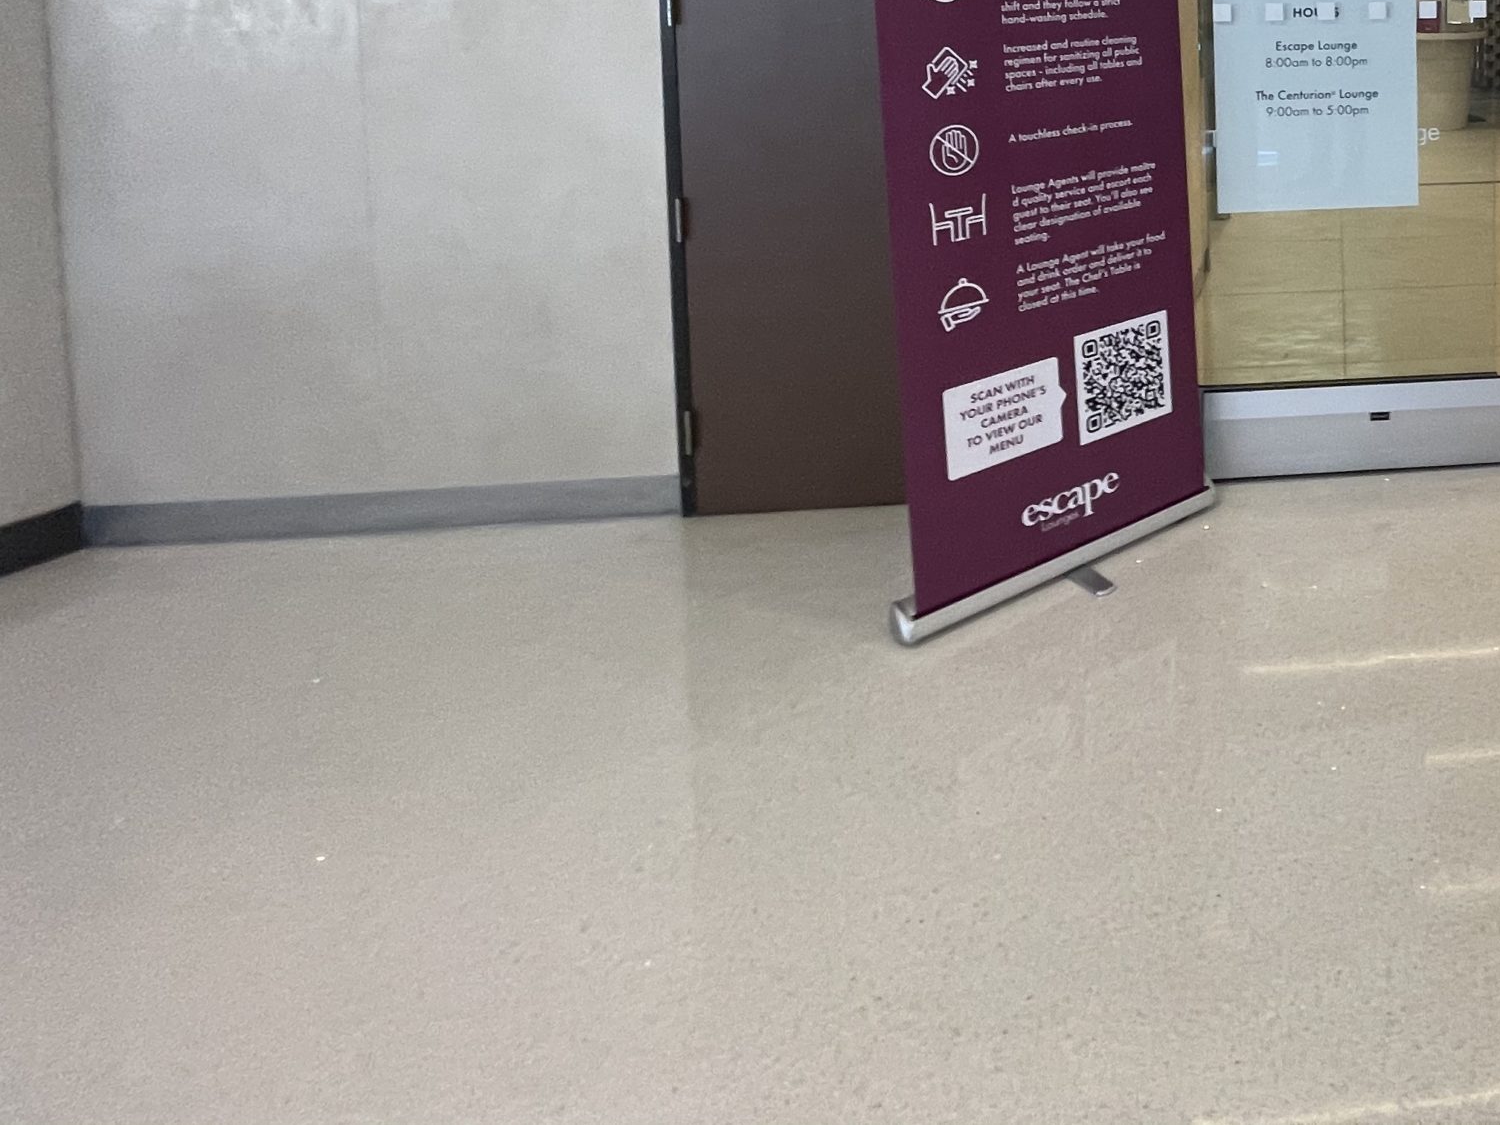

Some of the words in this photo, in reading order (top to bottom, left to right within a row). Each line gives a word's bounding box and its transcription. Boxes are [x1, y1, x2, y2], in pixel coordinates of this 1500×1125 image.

[1001, 1, 1020, 11] shift
[1022, 0, 1040, 10] and
[1043, 0, 1062, 10] they
[1293, 7, 1339, 18] HOS
[1002, 11, 1067, 24] hand-washing
[1003, 40, 1048, 53] Increased
[1050, 39, 1068, 49] and
[1070, 38, 1100, 47] routine
[1102, 35, 1137, 45] cleaning
[1276, 41, 1314, 53] Escape
[1318, 40, 1357, 52] Lounge
[1004, 55, 1041, 68] regimen
[1044, 53, 1057, 62] for
[1060, 50, 1100, 61] sanitizing
[1102, 48, 1112, 57] all
[1114, 46, 1140, 58] public
[1265, 58, 1308, 68] 8:00am
[1312, 57, 1321, 66] to
[1326, 56, 1368, 69] 8:00pm
[1005, 70, 1036, 82] spaces
[1045, 63, 1085, 75] including
[1087, 61, 1097, 70] all
[1126, 57, 1142, 66] and
[1006, 80, 1033, 92] chairs
[1035, 78, 1056, 88] after
[1059, 77, 1084, 86] every
[1256, 91, 1274, 101] The
[1339, 89, 1379, 101] Lounge
[1266, 107, 1309, 116] 9:00am
[1313, 107, 1323, 116] to
[1326, 105, 1369, 117] 5:00pm
[1008, 134, 1016, 143] A
[1019, 128, 1060, 142] touchless
[1062, 123, 1098, 136] check-in
[1011, 182, 1045, 194] Lounge
[1048, 176, 1079, 189] Agents
[1081, 171, 1095, 181] will
[1097, 166, 1128, 180] provide
[1021, 192, 1053, 206] quality
[1055, 187, 1085, 199] service
[1088, 181, 1104, 192] and
[1106, 177, 1131, 189] escort
[1132, 173, 1151, 184] each
[1013, 208, 1037, 222] guest
[1040, 205, 1049, 214] to
[1051, 200, 1071, 212] their
[1121, 189, 1137, 199] also
[1013, 220, 1036, 232] clear
[1039, 210, 1091, 226] designation
[1093, 205, 1101, 216] of
[1016, 264, 1025, 274] A
[1027, 258, 1059, 272] Lounge
[1062, 251, 1089, 264] Agent
[1091, 245, 1105, 256] will
[1107, 242, 1124, 252] take
[1126, 237, 1144, 249] your
[1146, 231, 1166, 243] food
[1017, 275, 1035, 286] and
[1037, 267, 1060, 282] drink
[1062, 263, 1087, 275] order
[1089, 257, 1105, 269] and
[1107, 250, 1135, 264] deliver
[1018, 289, 1039, 302] your
[1065, 276, 1080, 287] The
[1018, 298, 1048, 312] closed
[1050, 294, 1059, 304] at
[1061, 289, 1076, 300] this
[970, 386, 1002, 403] SCAN
[1005, 375, 1035, 391] WITH
[960, 402, 992, 421] YOUR
[997, 385, 1047, 408] PHONE'S
[981, 406, 1028, 428] CAMERA
[967, 435, 982, 447] TO
[986, 424, 1014, 441] VIEW
[1019, 414, 1043, 429] OUR
[989, 435, 1024, 454] MENU
[1022, 472, 1120, 526] escape
